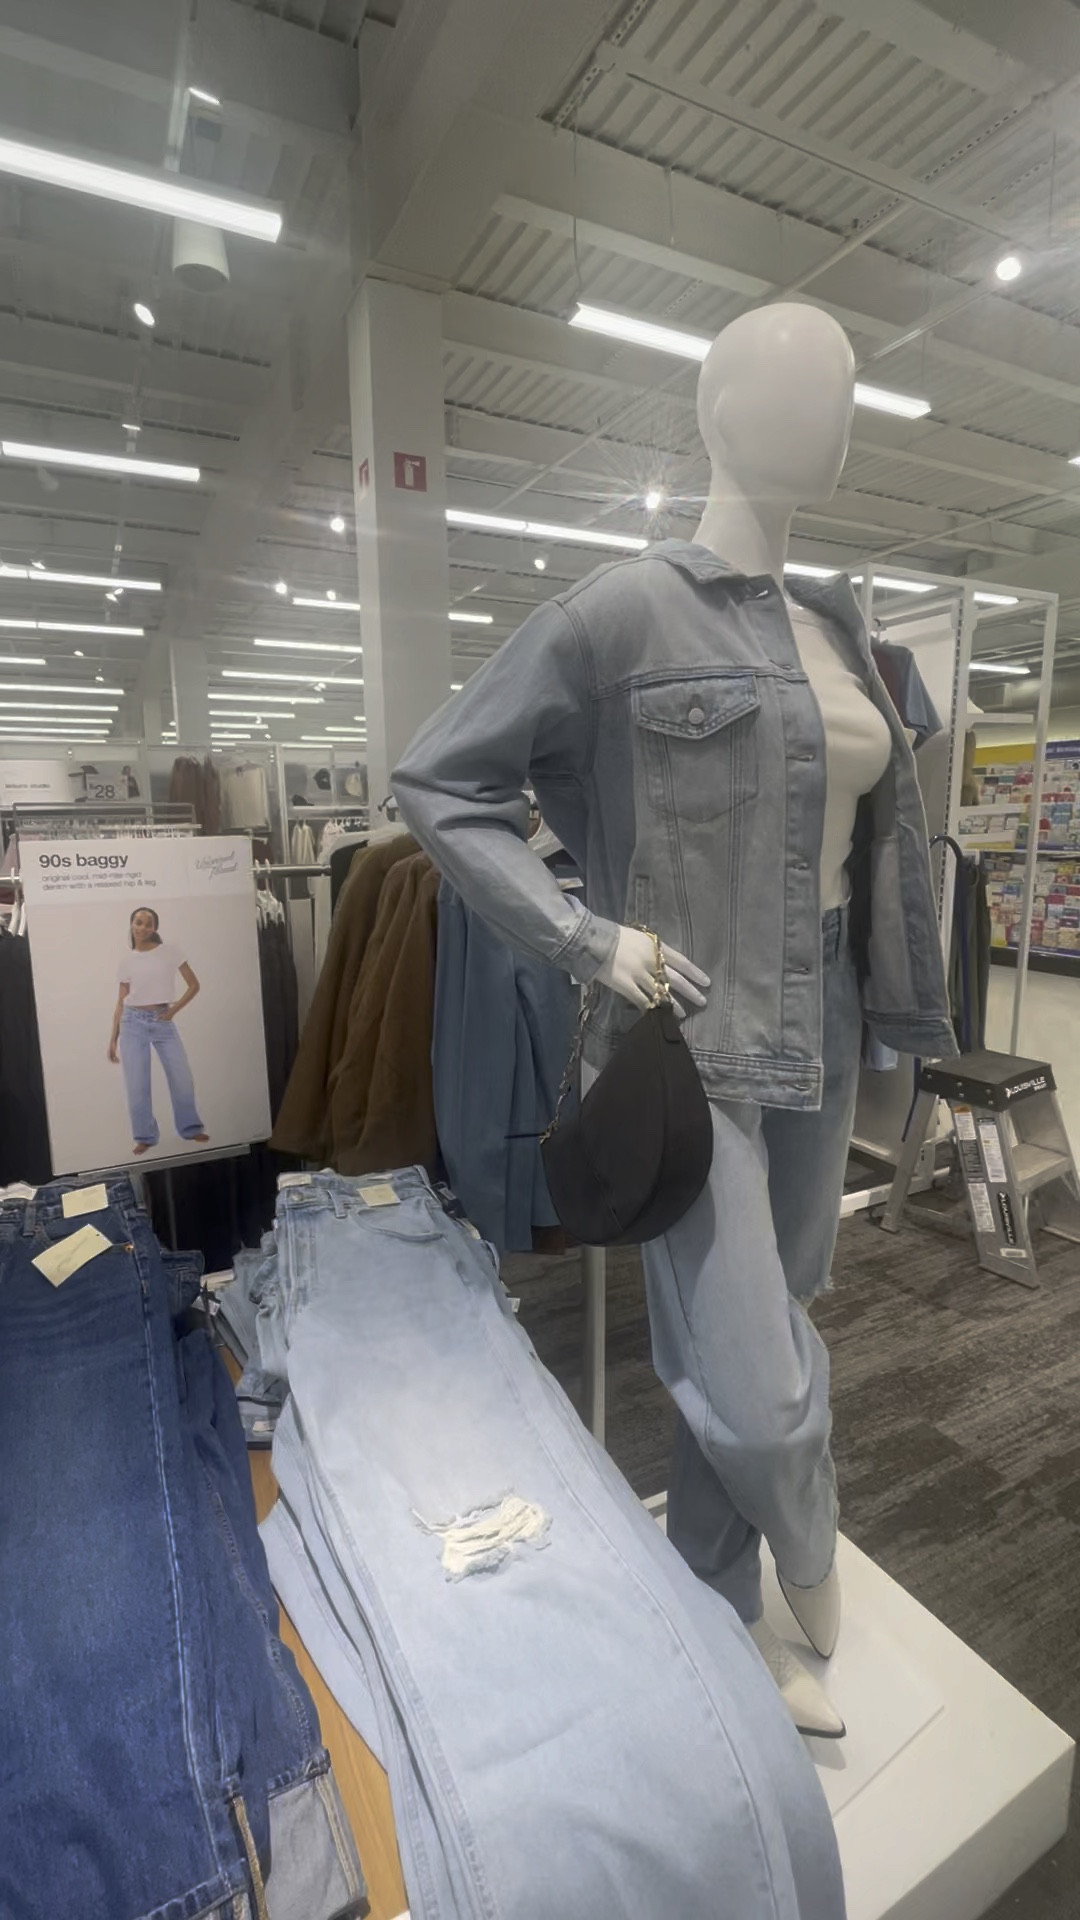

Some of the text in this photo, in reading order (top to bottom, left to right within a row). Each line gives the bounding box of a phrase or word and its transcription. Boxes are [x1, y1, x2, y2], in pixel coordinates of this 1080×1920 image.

[39, 853, 129, 869] 90s baggy
[137, 879, 143, 887] &
